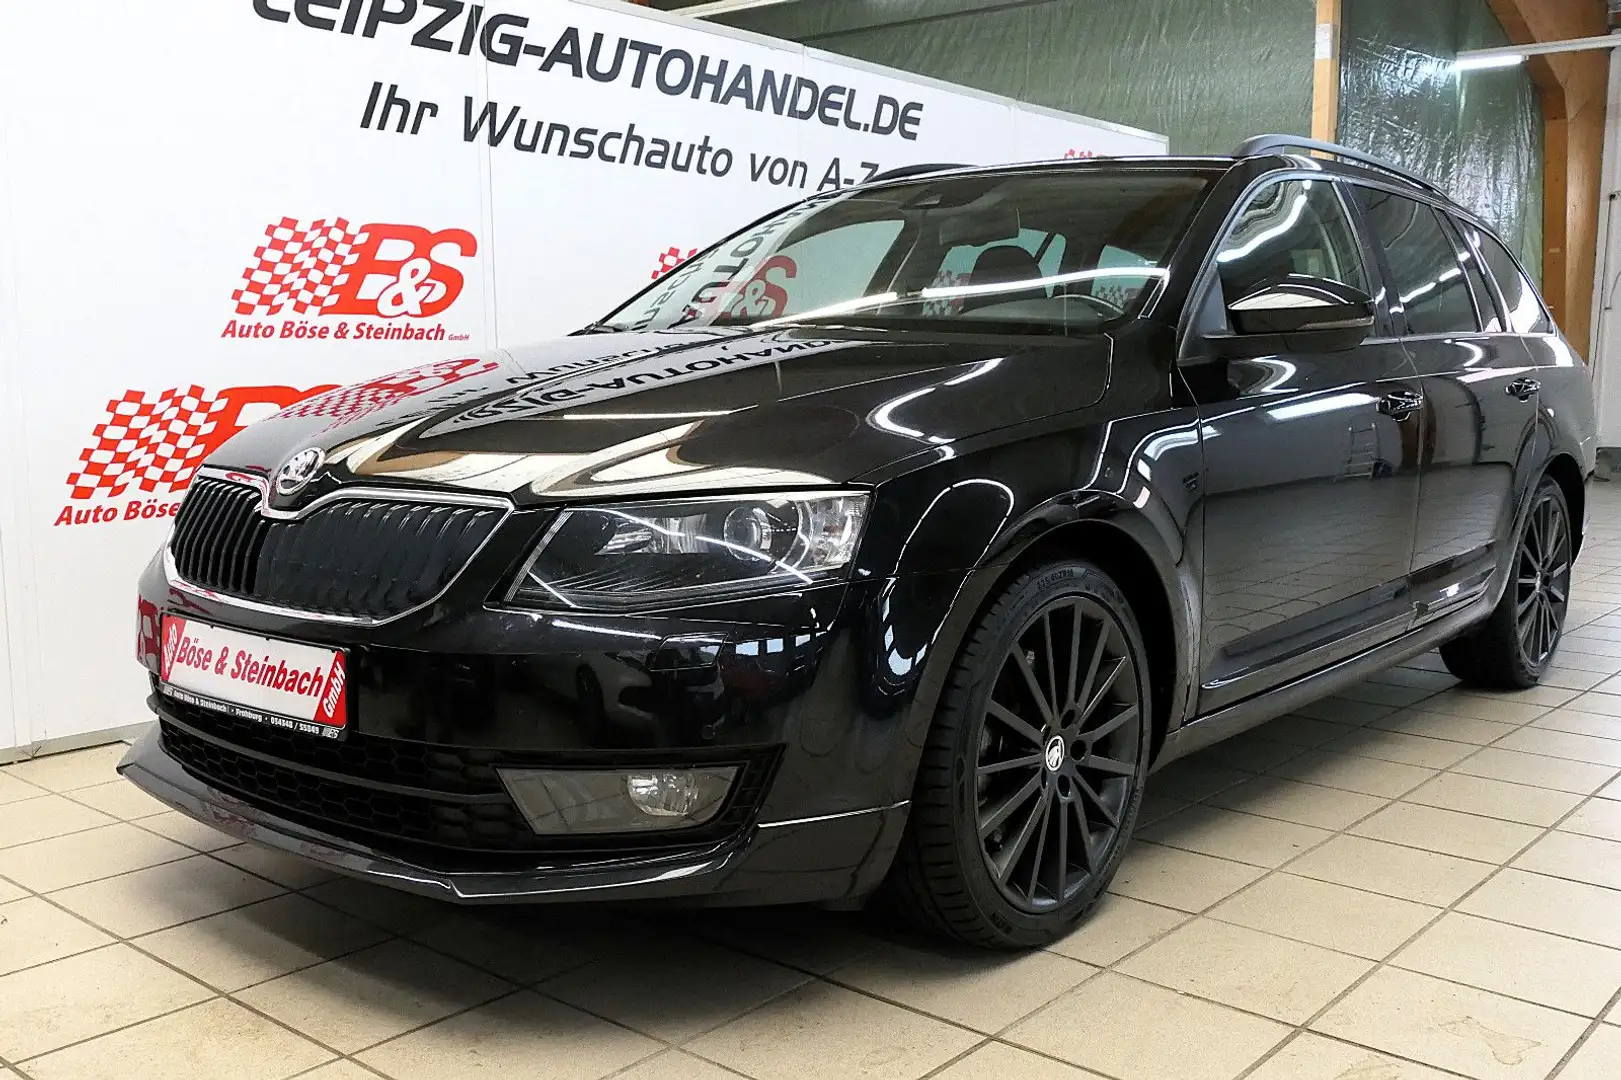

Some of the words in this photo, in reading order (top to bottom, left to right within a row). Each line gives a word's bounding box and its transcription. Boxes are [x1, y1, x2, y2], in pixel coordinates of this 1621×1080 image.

[359, 81, 439, 135] Ihr
[462, 95, 733, 178] Wunschauto
[749, 152, 808, 189] von
[816, 156, 880, 192] A-Z
[318, 222, 478, 319] B&S
[220, 319, 275, 340] Auto
[279, 320, 329, 340] Böse
[333, 321, 350, 340] &
[352, 321, 446, 342] Steinbach
[447, 333, 471, 341] GmbH
[53, 505, 118, 527] Auto
[123, 498, 182, 521] Böse
[175, 636, 213, 671] Böse
[214, 646, 229, 676] &
[230, 650, 324, 698] Steinbach
[322, 660, 346, 719] GmbH
[200, 699, 227, 713] Steinbach
